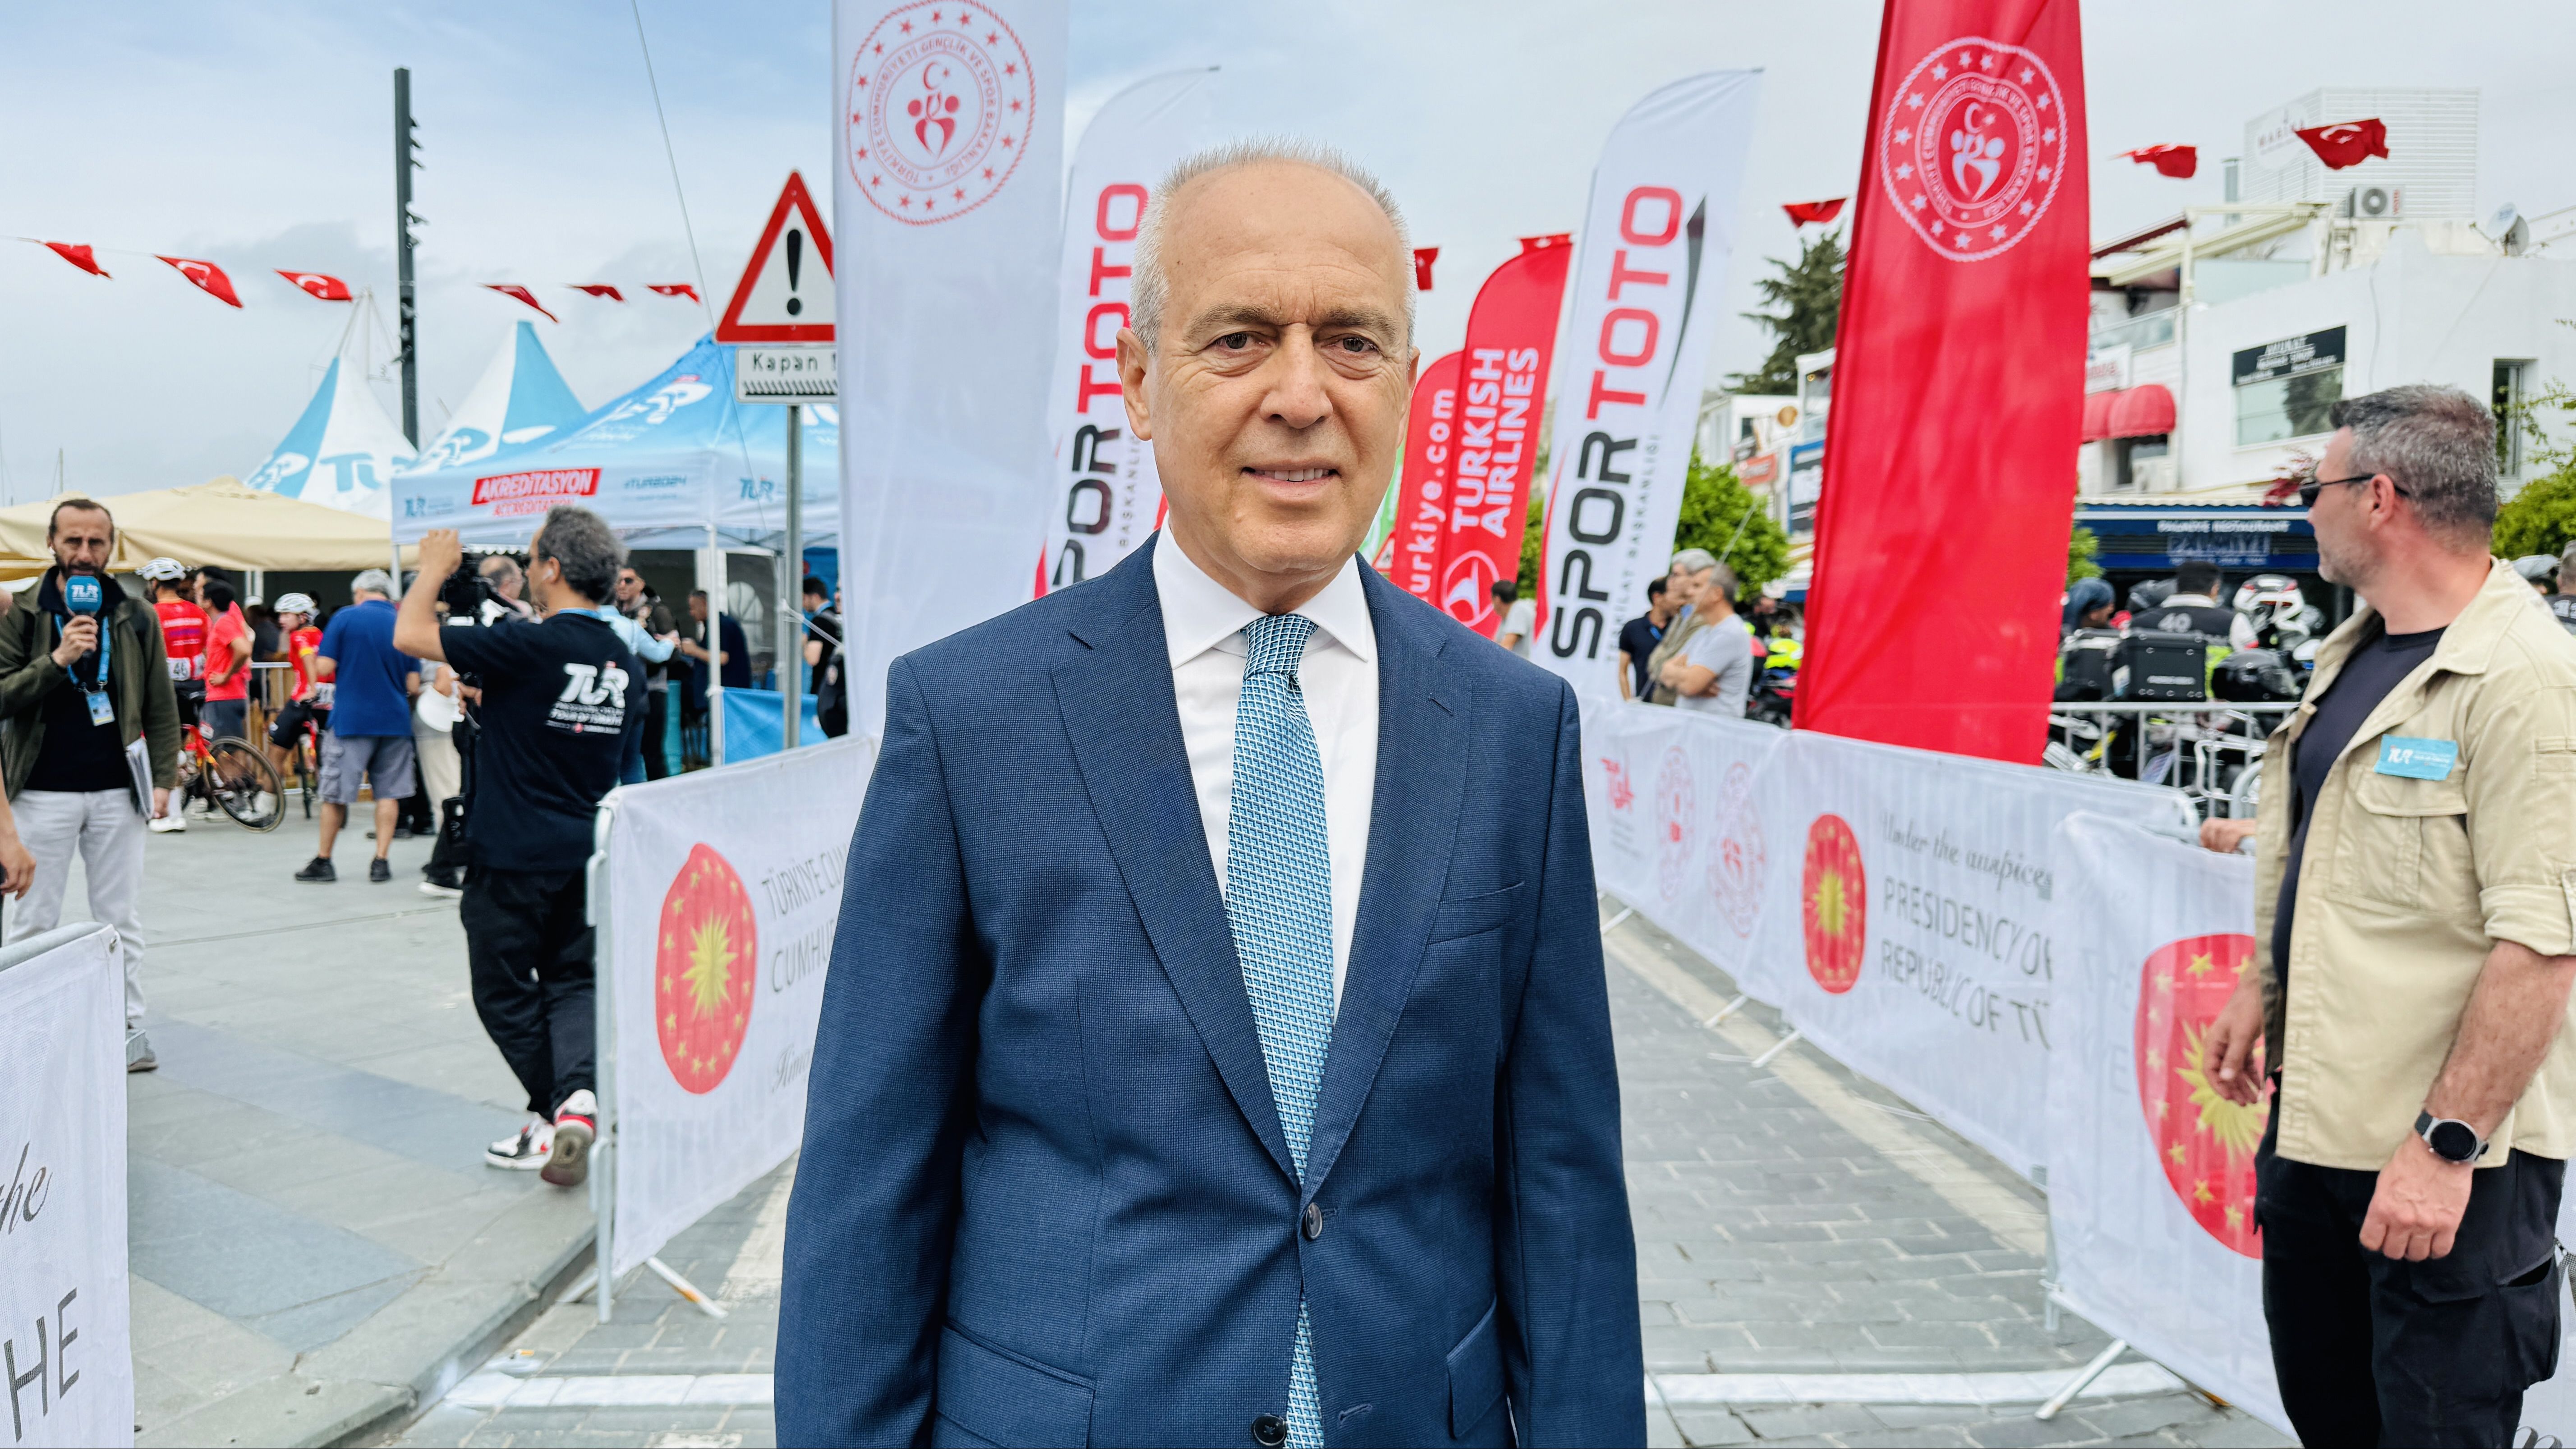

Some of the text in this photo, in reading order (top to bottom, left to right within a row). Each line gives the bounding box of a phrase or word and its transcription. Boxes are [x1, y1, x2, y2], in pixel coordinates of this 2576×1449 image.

[969, 51, 984, 67] VE
[754, 353, 819, 375] Kapan
[319, 452, 417, 491] TU
[1452, 348, 1505, 534] TURKISH
[1481, 347, 1539, 539] AIRLINES
[1053, 423, 1121, 588] POR
[1406, 388, 1456, 602] urkiye.com
[559, 661, 630, 709] TUR
[761, 858, 826, 920] TÜRKİYE
[1933, 826, 1960, 866] the
[1883, 875, 2025, 963] PRESIDENCY
[1881, 938, 1973, 1017] REPUBLIC
[1967, 985, 2002, 1032] OF
[0, 1141, 53, 1235] he
[4, 1287, 80, 1443] HE
